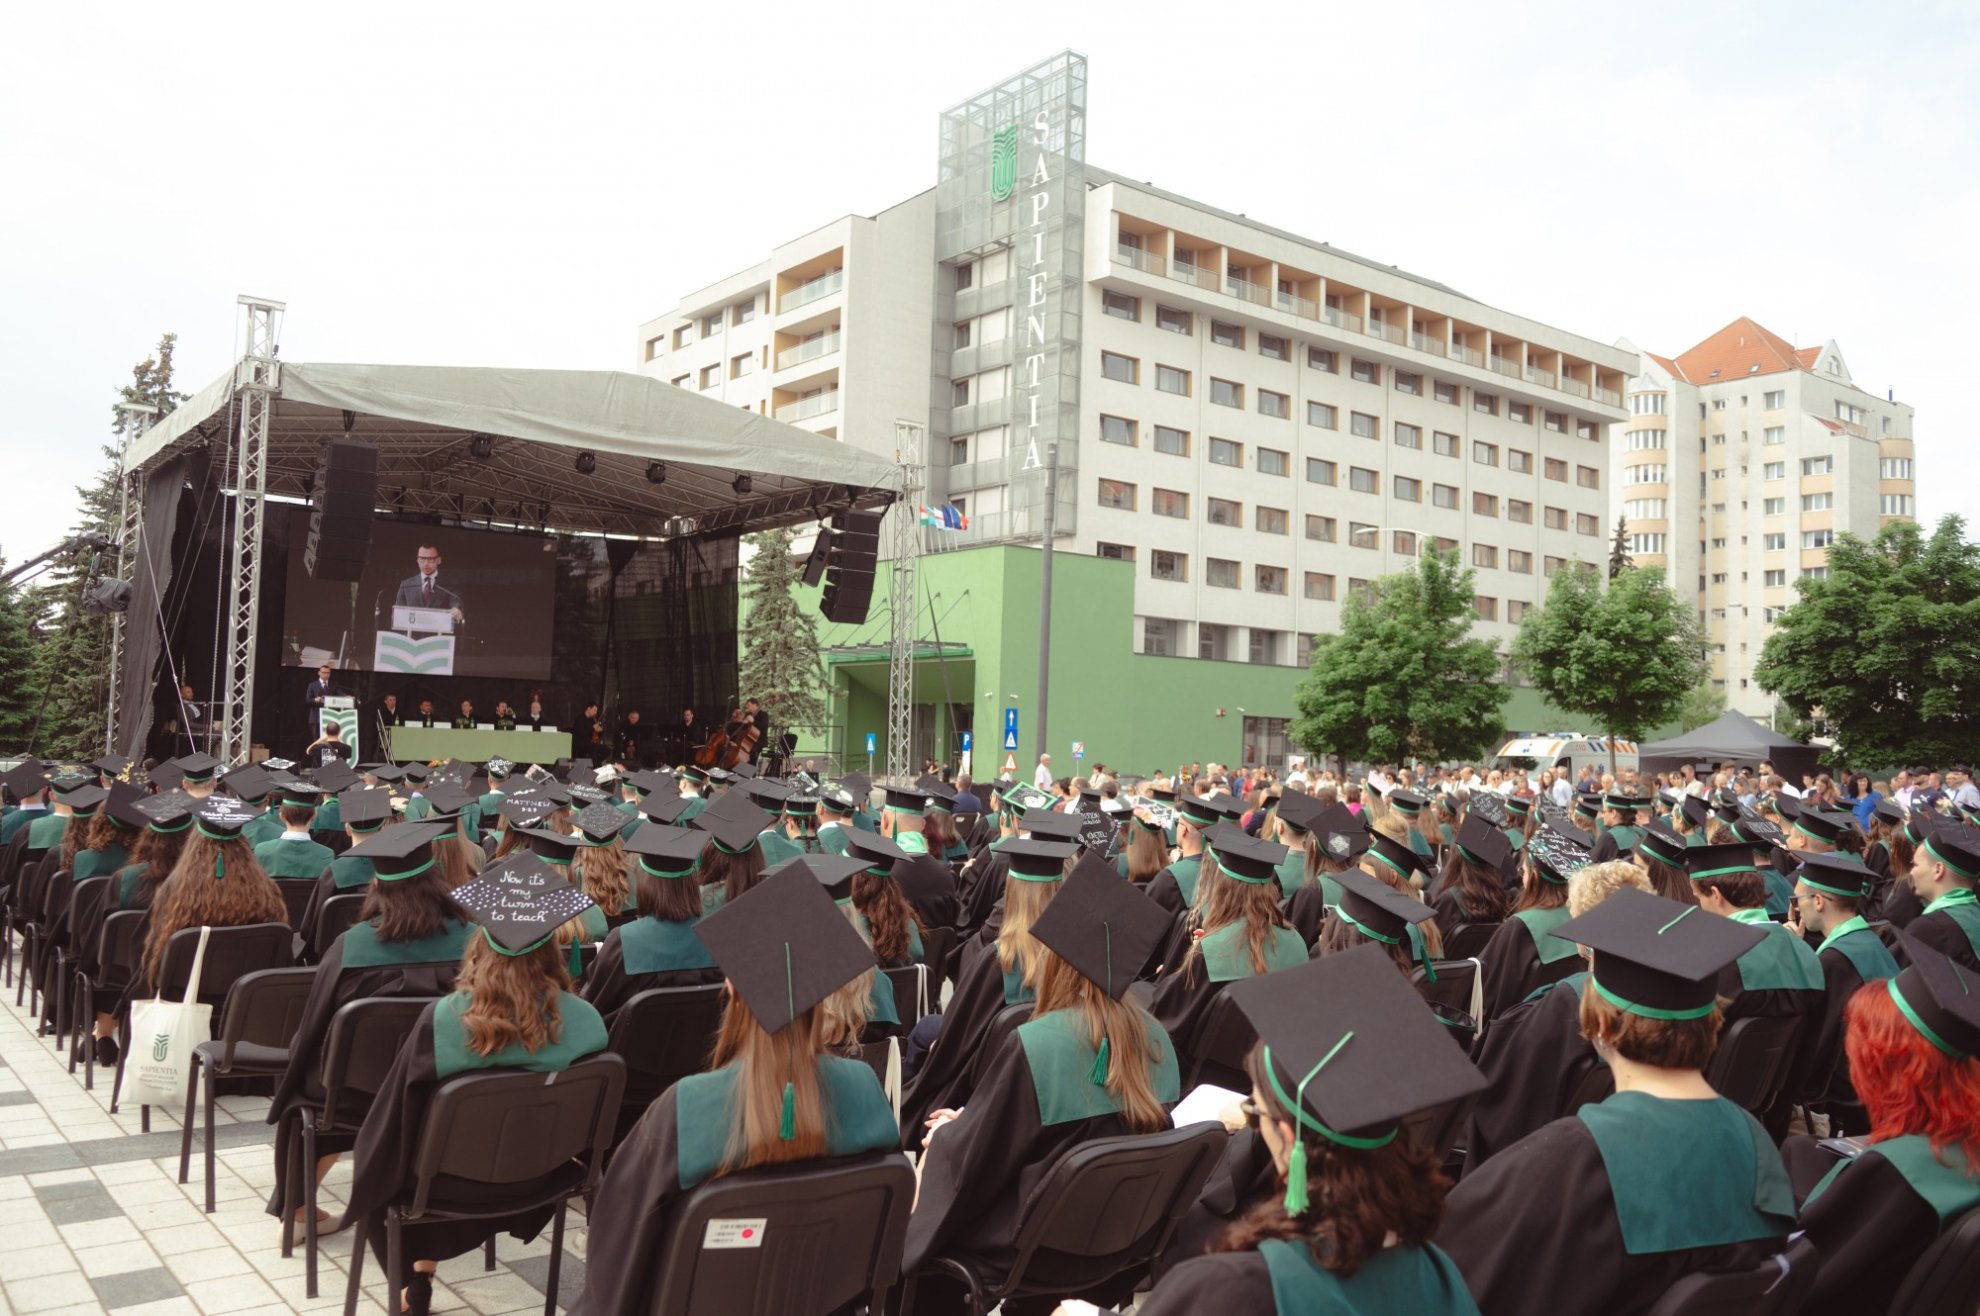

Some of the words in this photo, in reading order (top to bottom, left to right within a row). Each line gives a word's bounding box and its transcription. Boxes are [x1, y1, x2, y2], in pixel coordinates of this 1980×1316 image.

[1021, 110, 1051, 470] SAPIENTIA
[964, 734, 969, 746] P
[506, 798, 551, 808] MATTHEW
[500, 870, 523, 885] Now
[528, 872, 545, 886] it's
[508, 888, 531, 900] my
[491, 910, 504, 921] to
[511, 910, 546, 922] teach
[140, 1065, 178, 1075] SAPIENTIA
